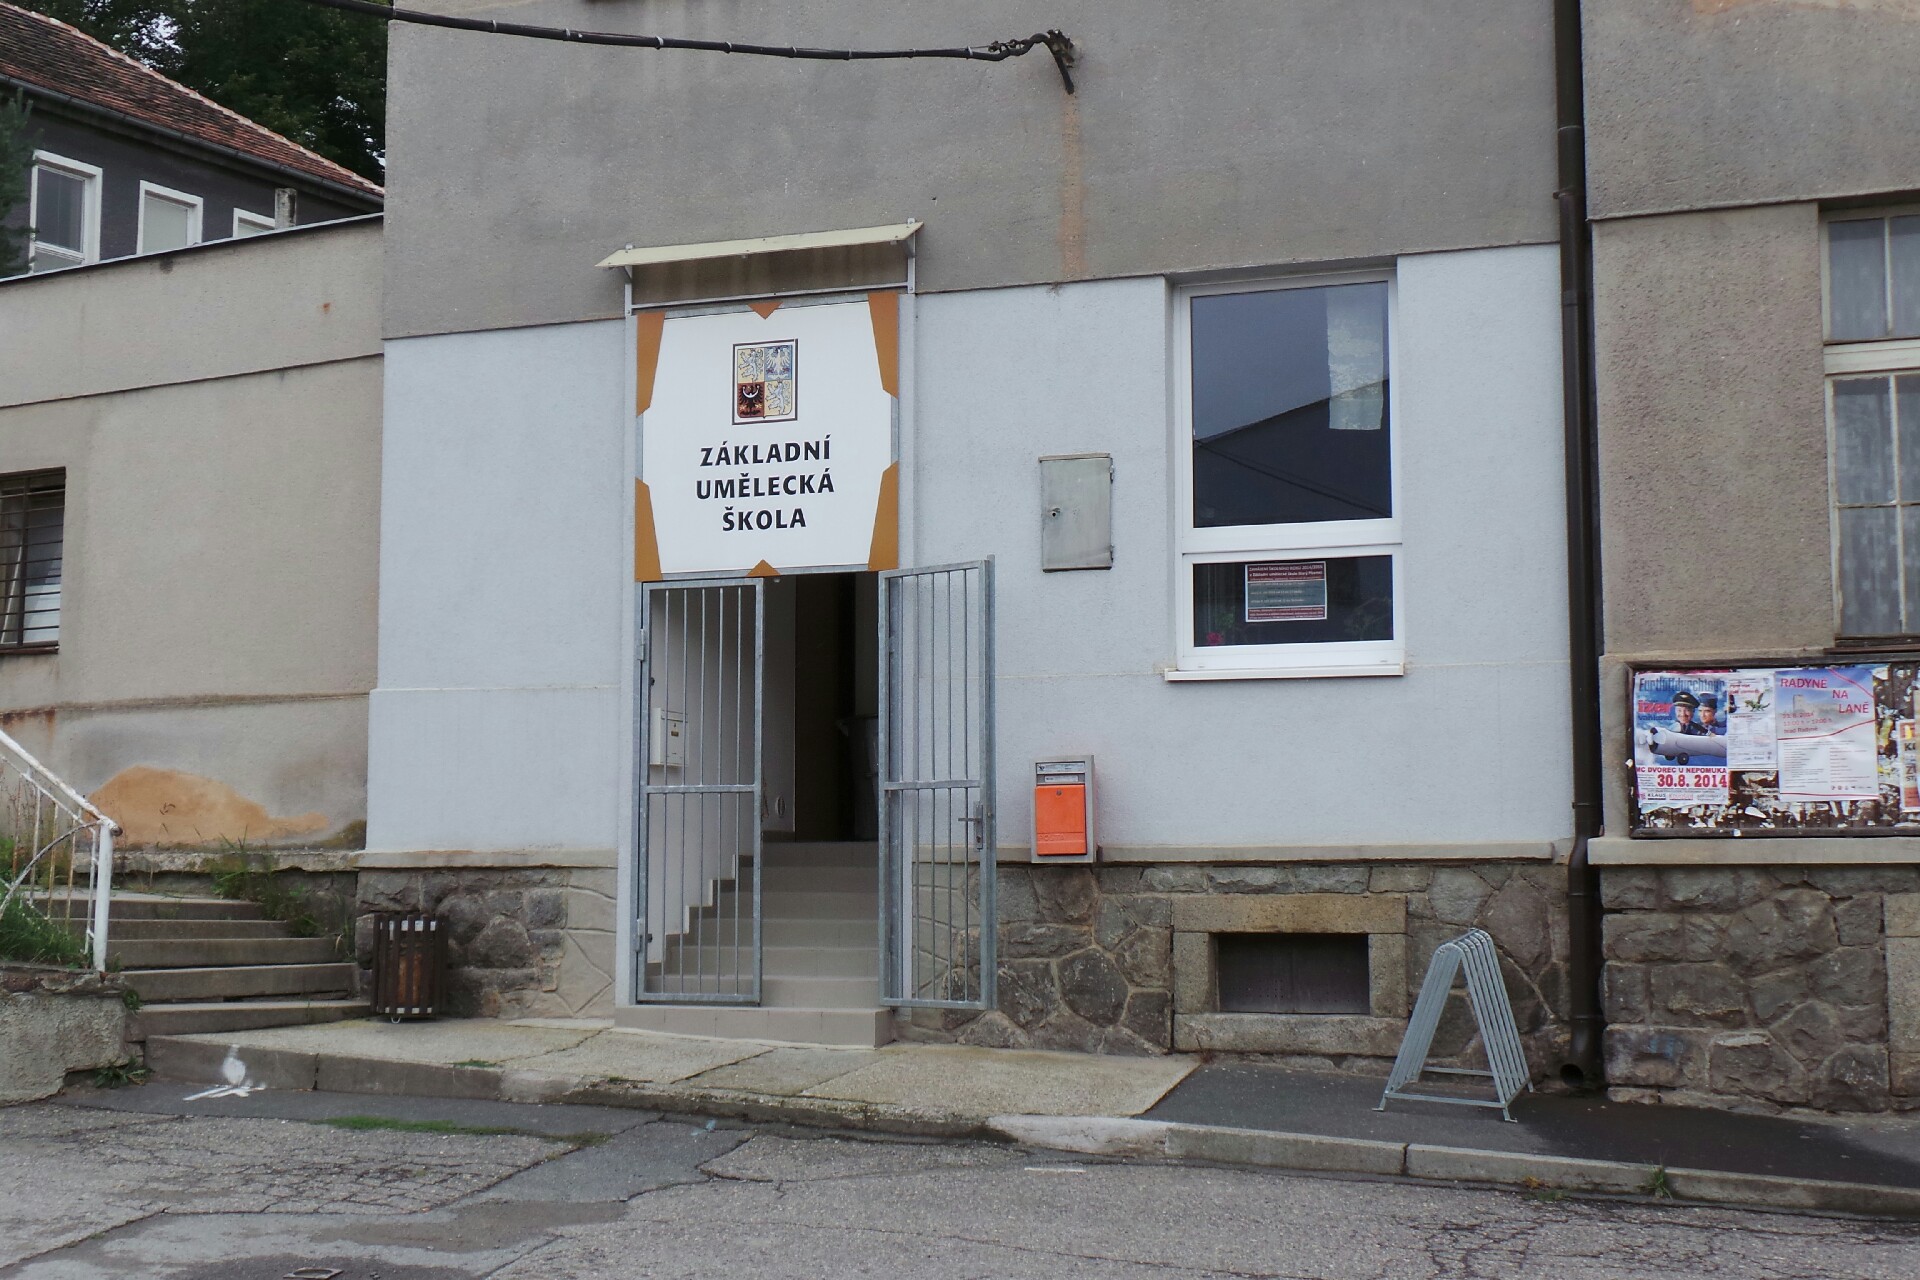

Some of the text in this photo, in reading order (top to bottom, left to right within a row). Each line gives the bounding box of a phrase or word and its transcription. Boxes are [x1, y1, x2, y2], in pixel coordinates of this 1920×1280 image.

[699, 434, 832, 467] ZÁKLADNÍ
[696, 468, 835, 500] UMĚLECKÁ
[721, 506, 807, 531] ŠKOLA
[1832, 689, 1848, 699] NA
[1657, 774, 1689, 787] 30.8.
[1694, 774, 1727, 788] 2014
